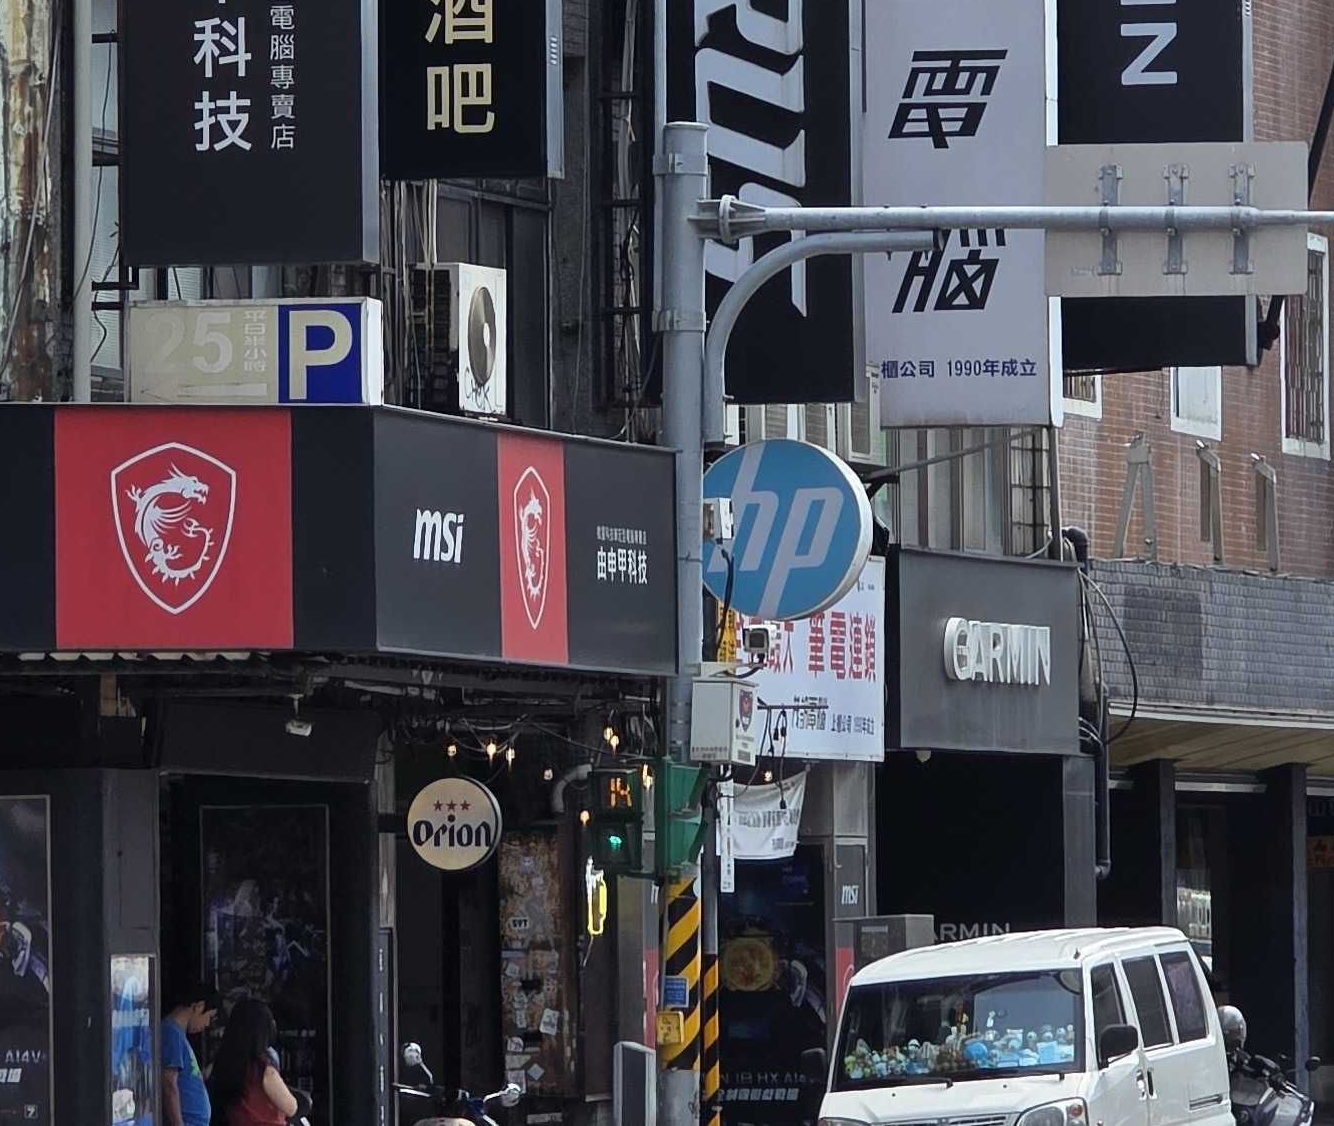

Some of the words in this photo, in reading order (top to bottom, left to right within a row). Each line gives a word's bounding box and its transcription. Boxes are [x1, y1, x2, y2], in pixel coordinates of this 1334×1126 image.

[288, 309, 353, 401] P
[946, 358, 1037, 378] 1990年成立
[413, 508, 465, 563] msi
[707, 439, 844, 621] hp
[596, 545, 648, 586] 由申甲科技
[944, 616, 1052, 686] GARMIN
[412, 814, 493, 847] Orion
[841, 884, 859, 905] msi
[5, 1049, 47, 1064] A14V
